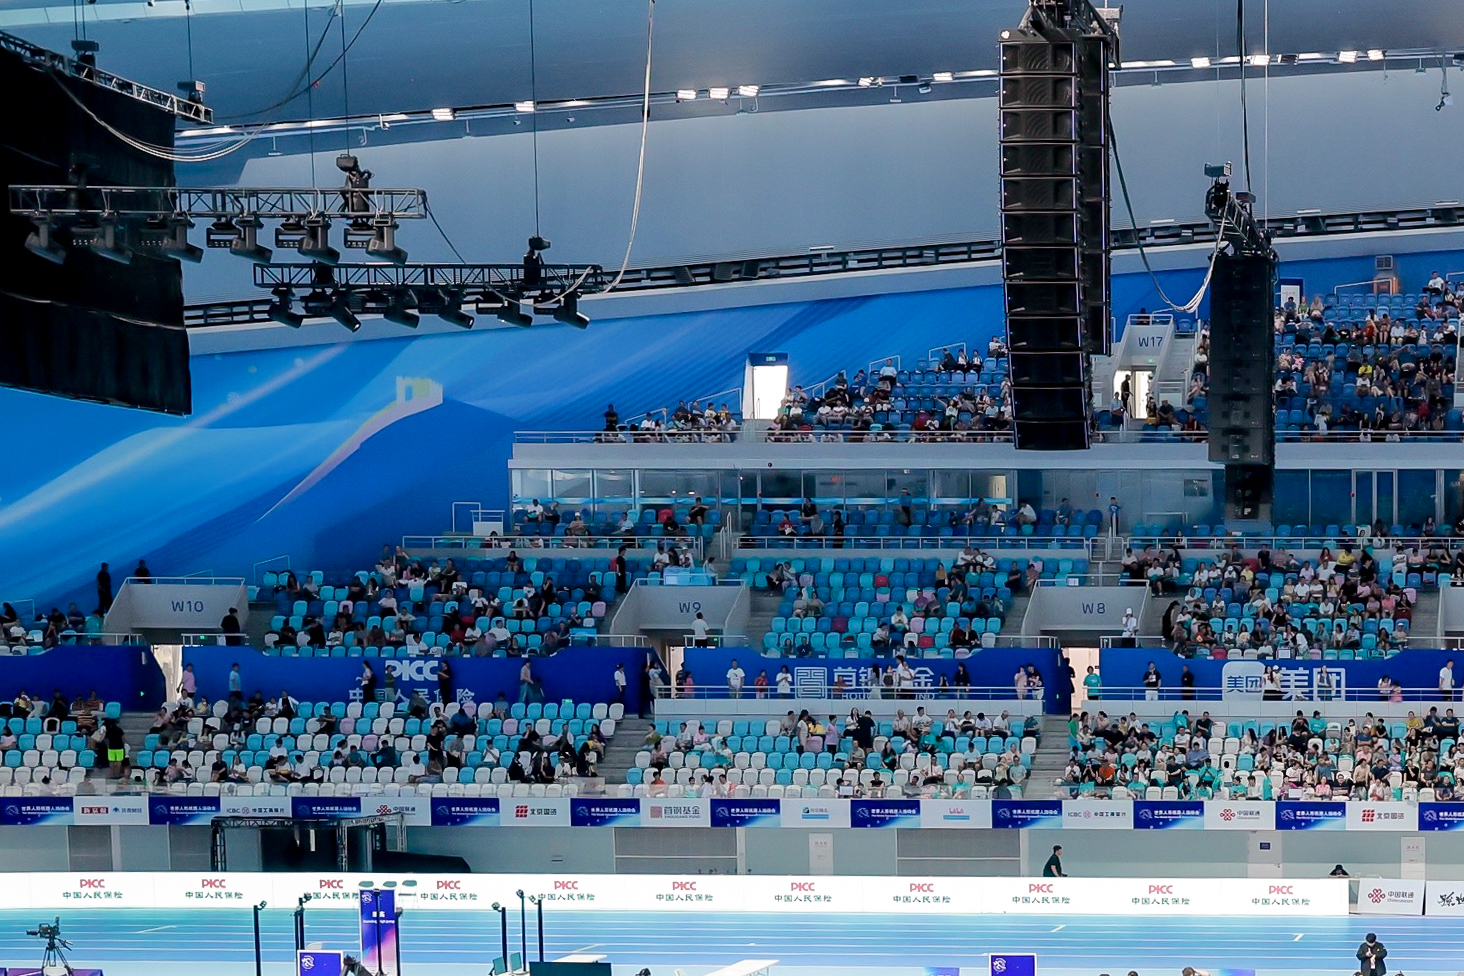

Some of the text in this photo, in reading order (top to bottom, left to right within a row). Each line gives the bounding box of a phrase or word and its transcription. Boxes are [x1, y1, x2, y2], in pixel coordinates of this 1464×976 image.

[1138, 336, 1163, 347] W17
[171, 600, 204, 613] W10
[1082, 602, 1105, 614] W8
[349, 688, 476, 705] 中国人民险
[80, 878, 105, 888] PICC
[201, 878, 226, 888] PICC
[319, 879, 343, 889] PICC
[437, 880, 460, 889] PICC
[554, 880, 578, 890] PICC
[672, 881, 696, 890] PICC
[791, 882, 815, 891] PICC
[909, 883, 933, 892] PICC
[1029, 883, 1053, 892] PICC
[1148, 884, 1173, 894] PICC
[1268, 885, 1293, 895] PICC
